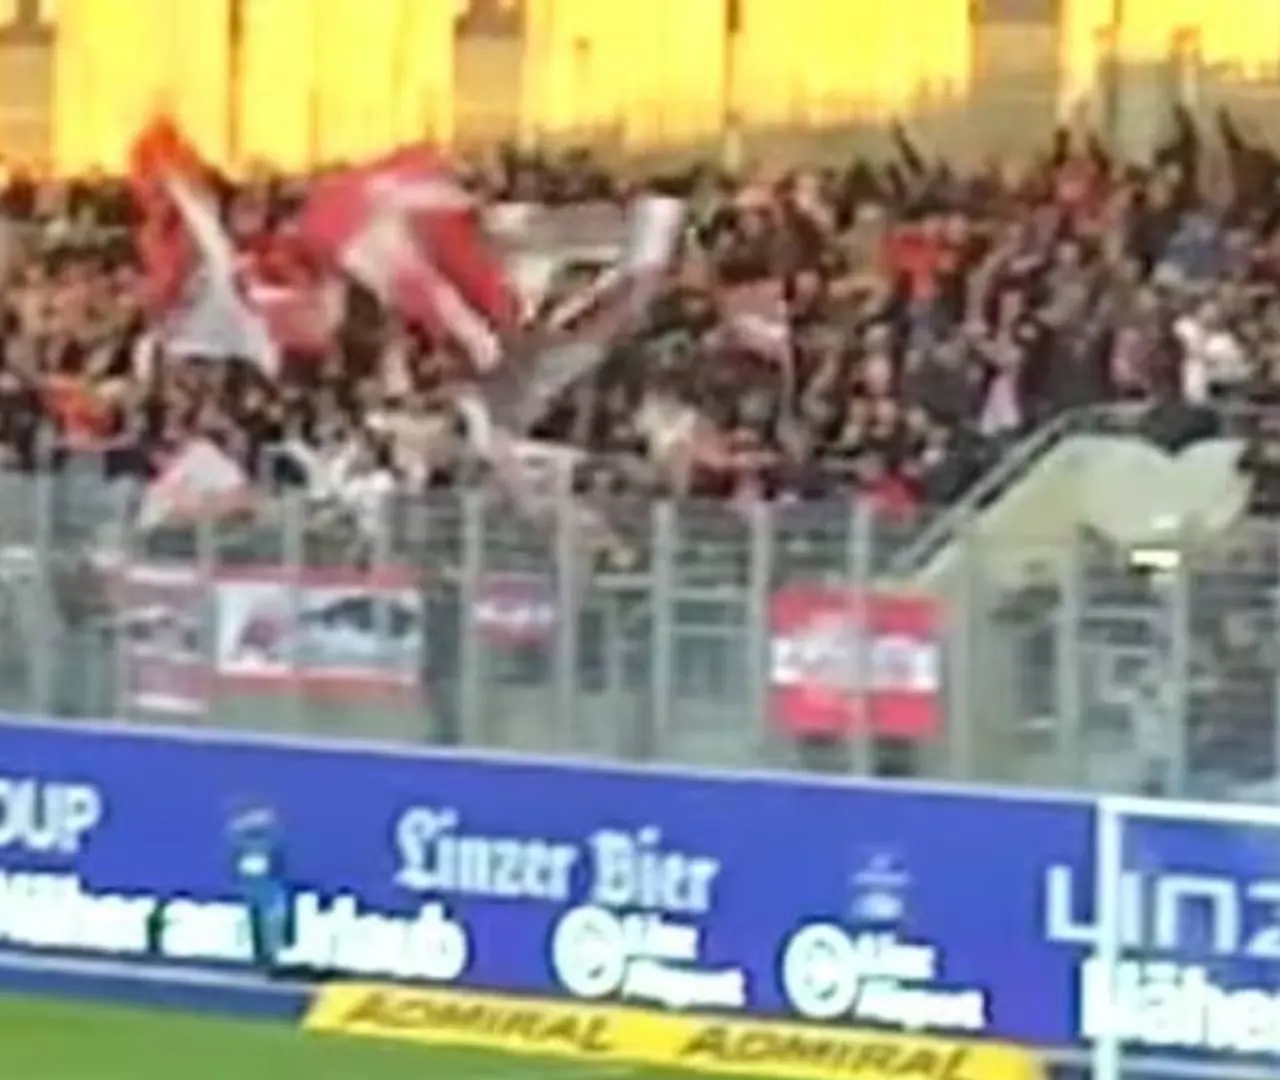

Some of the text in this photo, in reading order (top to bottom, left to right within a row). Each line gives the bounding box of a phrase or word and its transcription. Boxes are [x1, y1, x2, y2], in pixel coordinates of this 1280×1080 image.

[392, 806, 720, 913] Linzer Bier
[340, 990, 616, 1052] ADMIRAL
